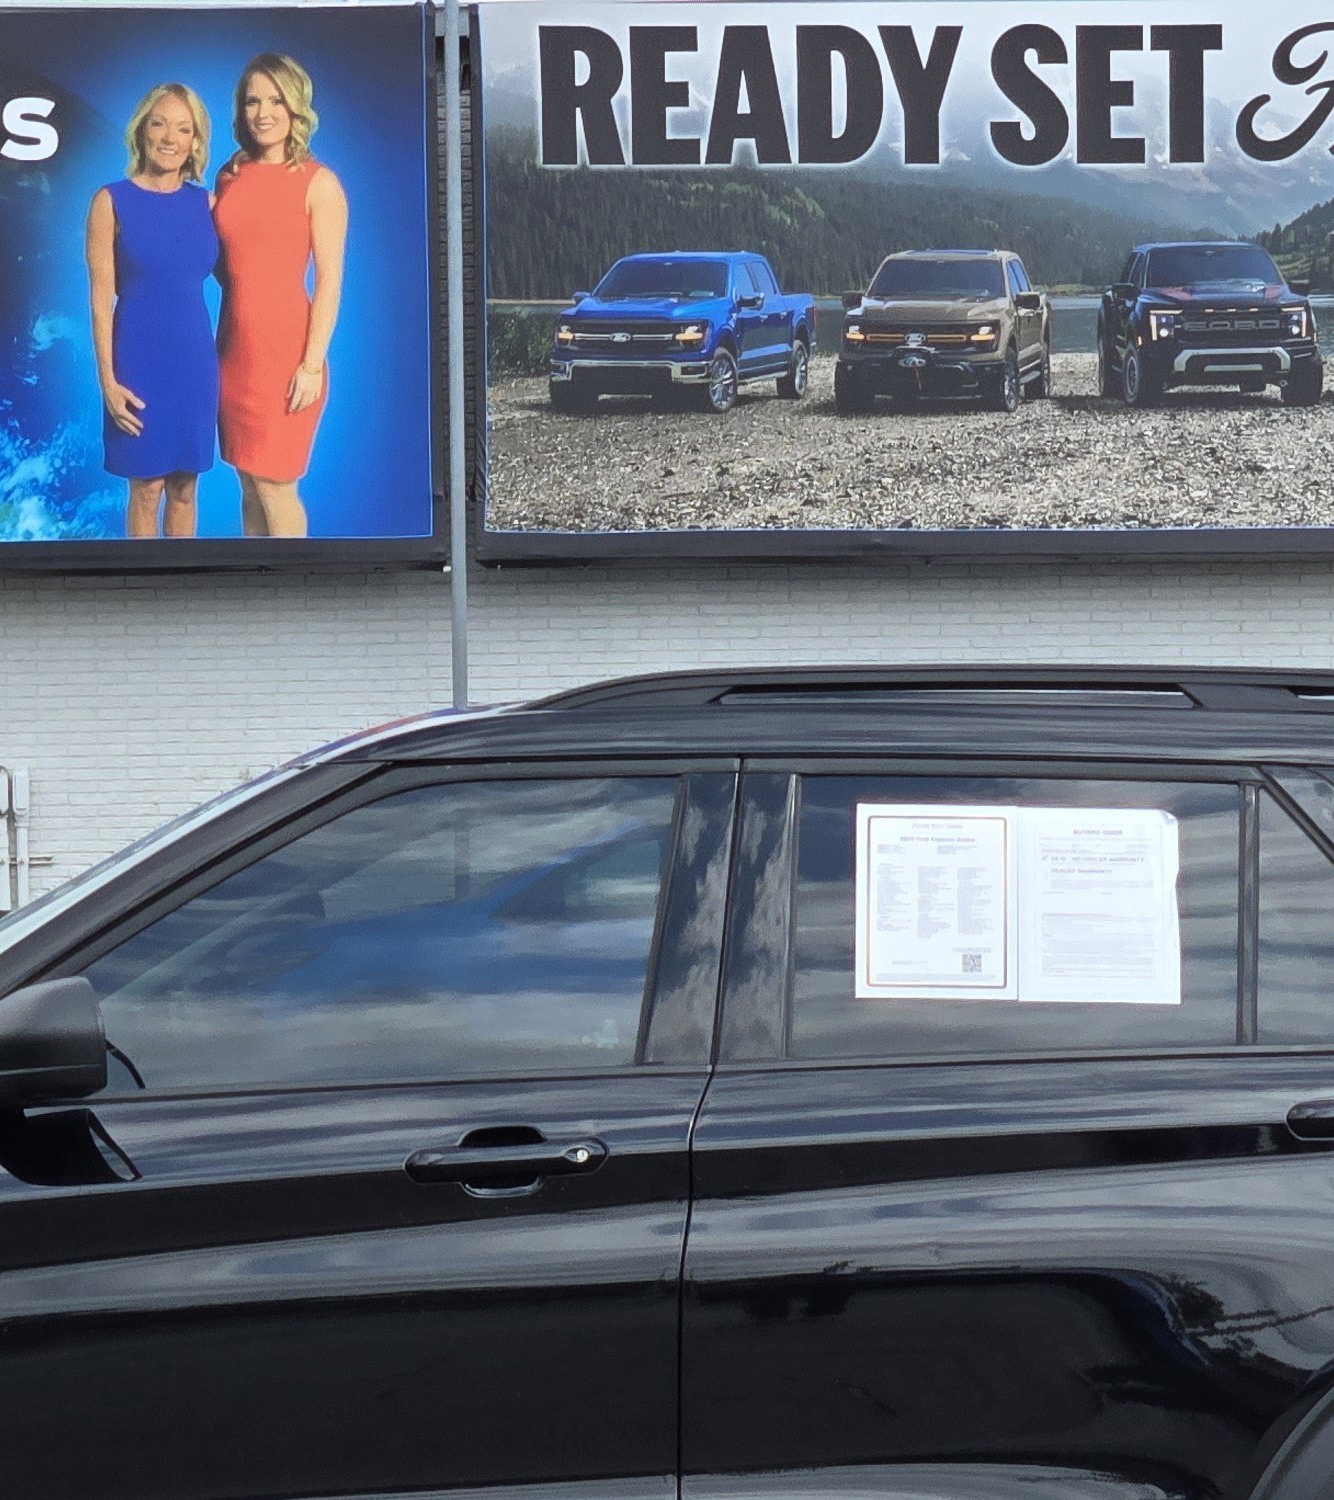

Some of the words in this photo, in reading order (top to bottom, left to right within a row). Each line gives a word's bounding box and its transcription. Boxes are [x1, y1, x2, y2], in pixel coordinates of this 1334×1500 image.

[538, 24, 964, 166] READY
[990, 23, 1223, 167] SET
[1182, 319, 1280, 331] FORD
